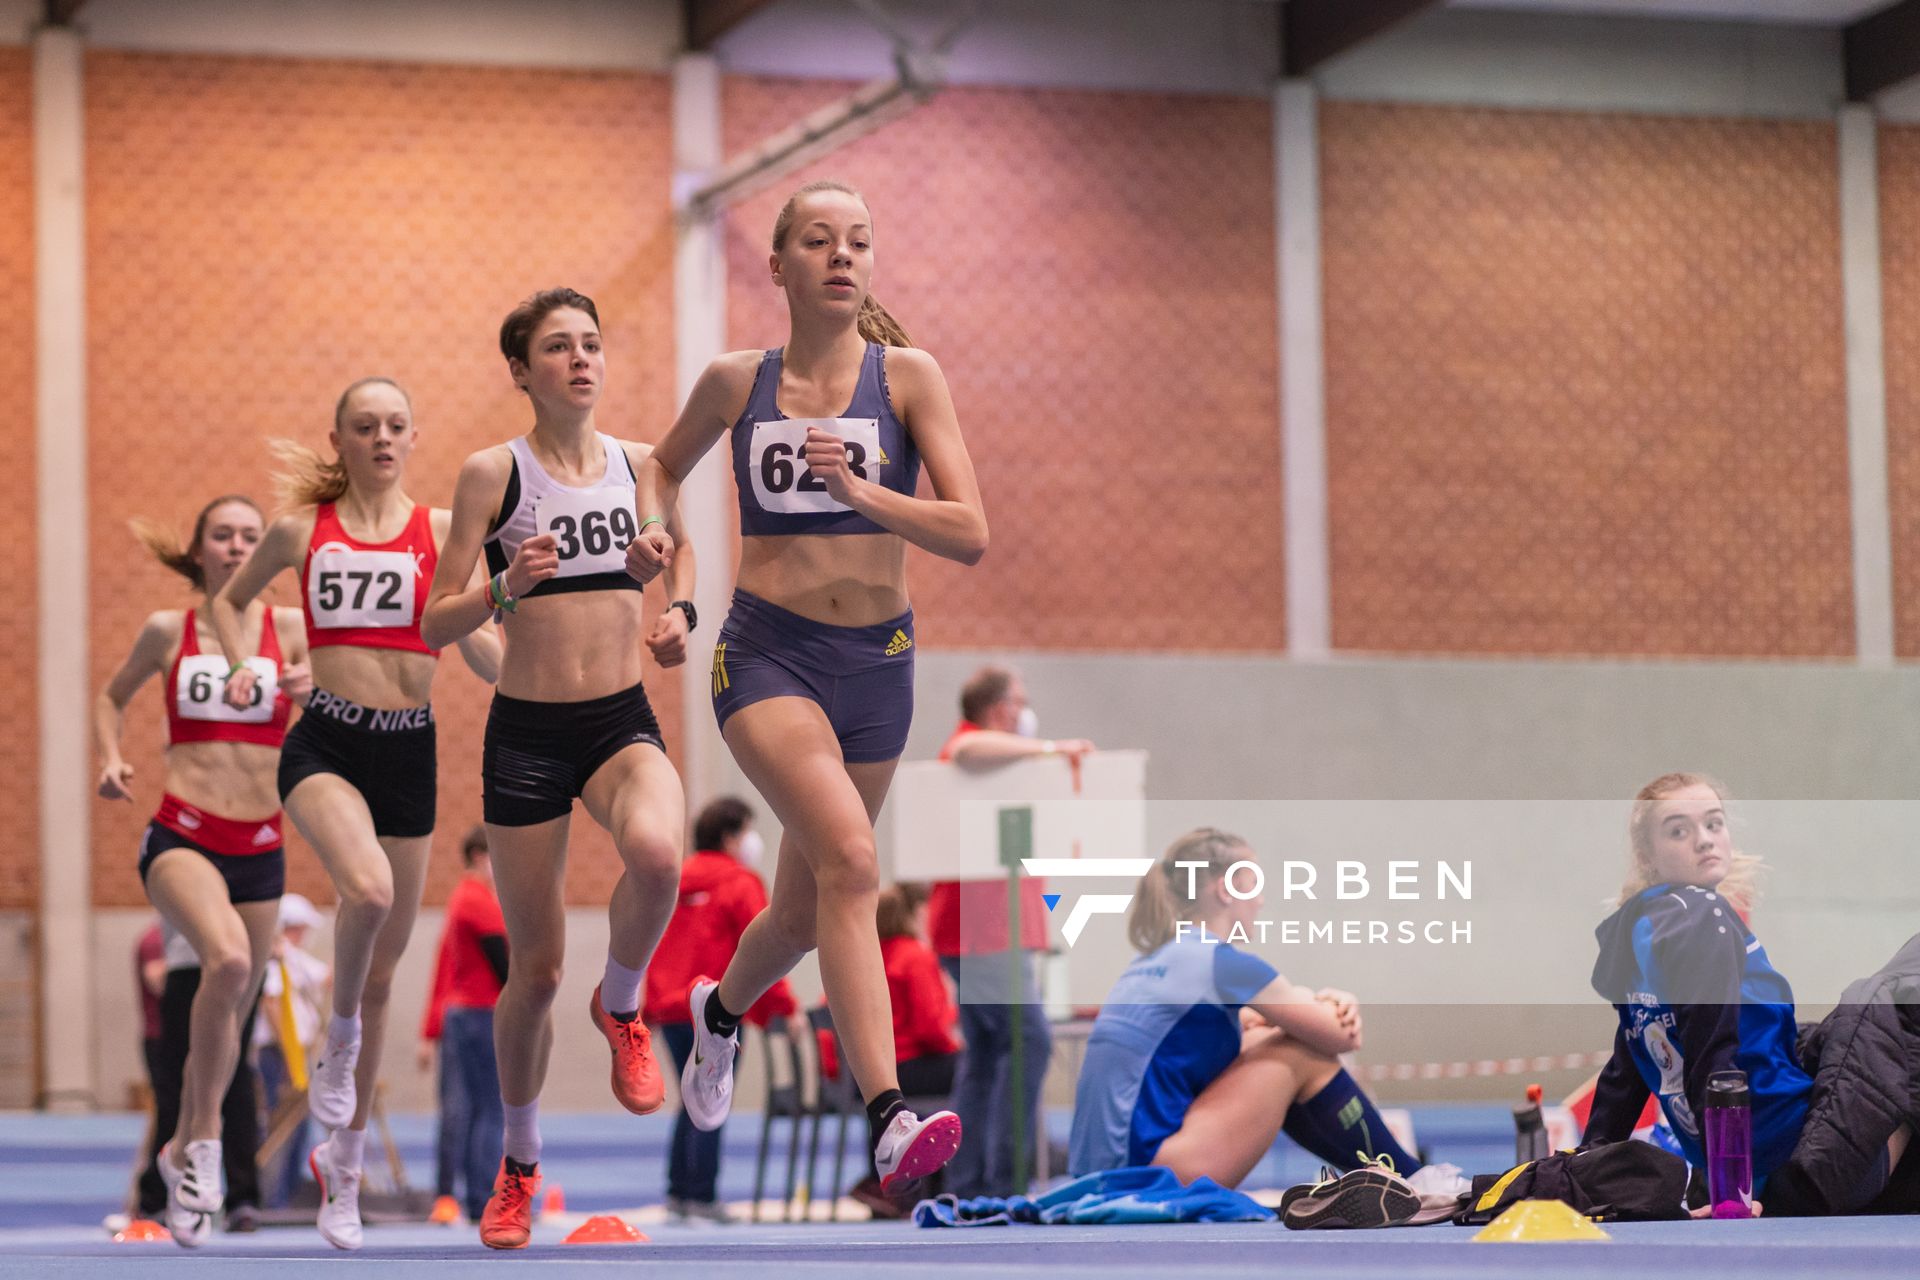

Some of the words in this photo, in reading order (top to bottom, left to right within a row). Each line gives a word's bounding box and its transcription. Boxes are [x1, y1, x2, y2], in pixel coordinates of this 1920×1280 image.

[549, 507, 637, 560] 369
[318, 571, 402, 611] 572
[885, 639, 912, 657] adidas
[310, 690, 364, 724] PRO
[369, 703, 427, 731] NIKE
